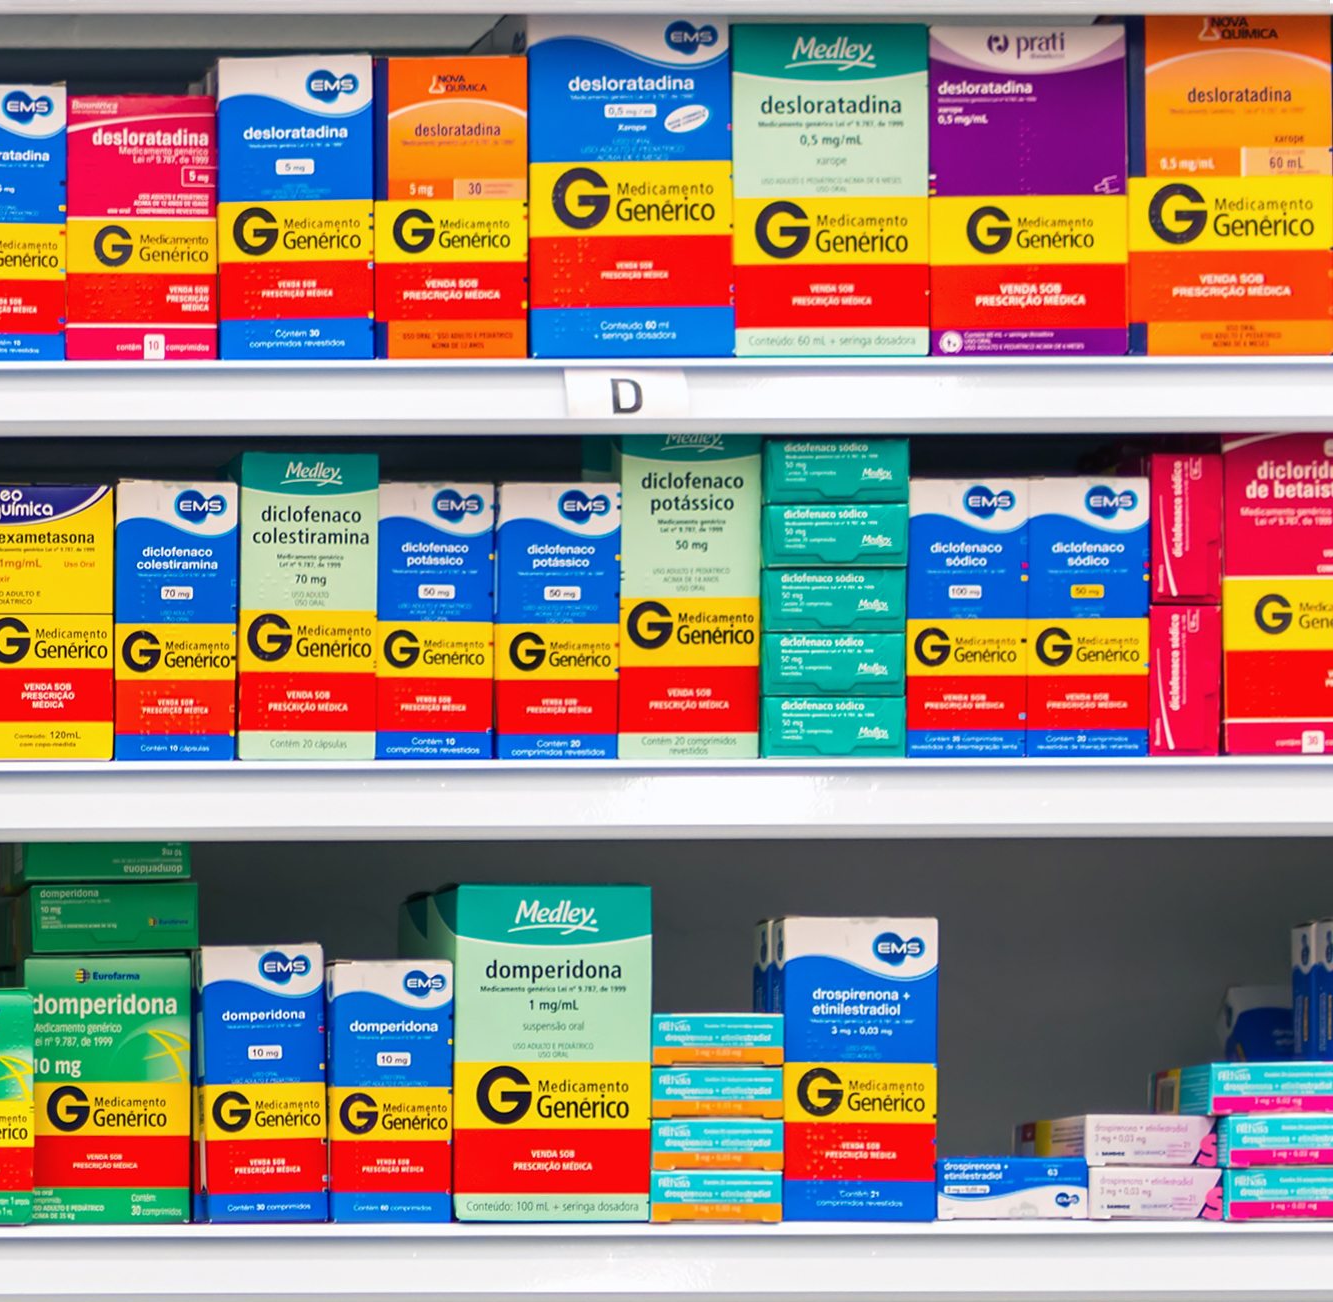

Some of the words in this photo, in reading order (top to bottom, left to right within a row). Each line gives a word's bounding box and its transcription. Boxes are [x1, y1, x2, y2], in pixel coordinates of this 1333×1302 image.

[1016, 31, 1065, 59] prati
[760, 94, 902, 115] desloratadina
[799, 134, 819, 147] 0,5
[821, 134, 862, 149] mg/mL
[797, 335, 811, 347] 60
[610, 378, 643, 414] D
[650, 493, 735, 515] potássico
[261, 505, 362, 523] diclofenaco
[252, 527, 370, 545] colestiramina
[780, 700, 834, 711] diclofenaco
[835, 701, 865, 711] sódico
[92, 971, 141, 981] Eurofarma
[485, 959, 622, 984] domperidona
[813, 1002, 901, 1016] etinilestradiol
[522, 1021, 567, 1033] suspensão
[568, 1020, 585, 1031] oral
[1047, 1168, 1059, 1177] 63
